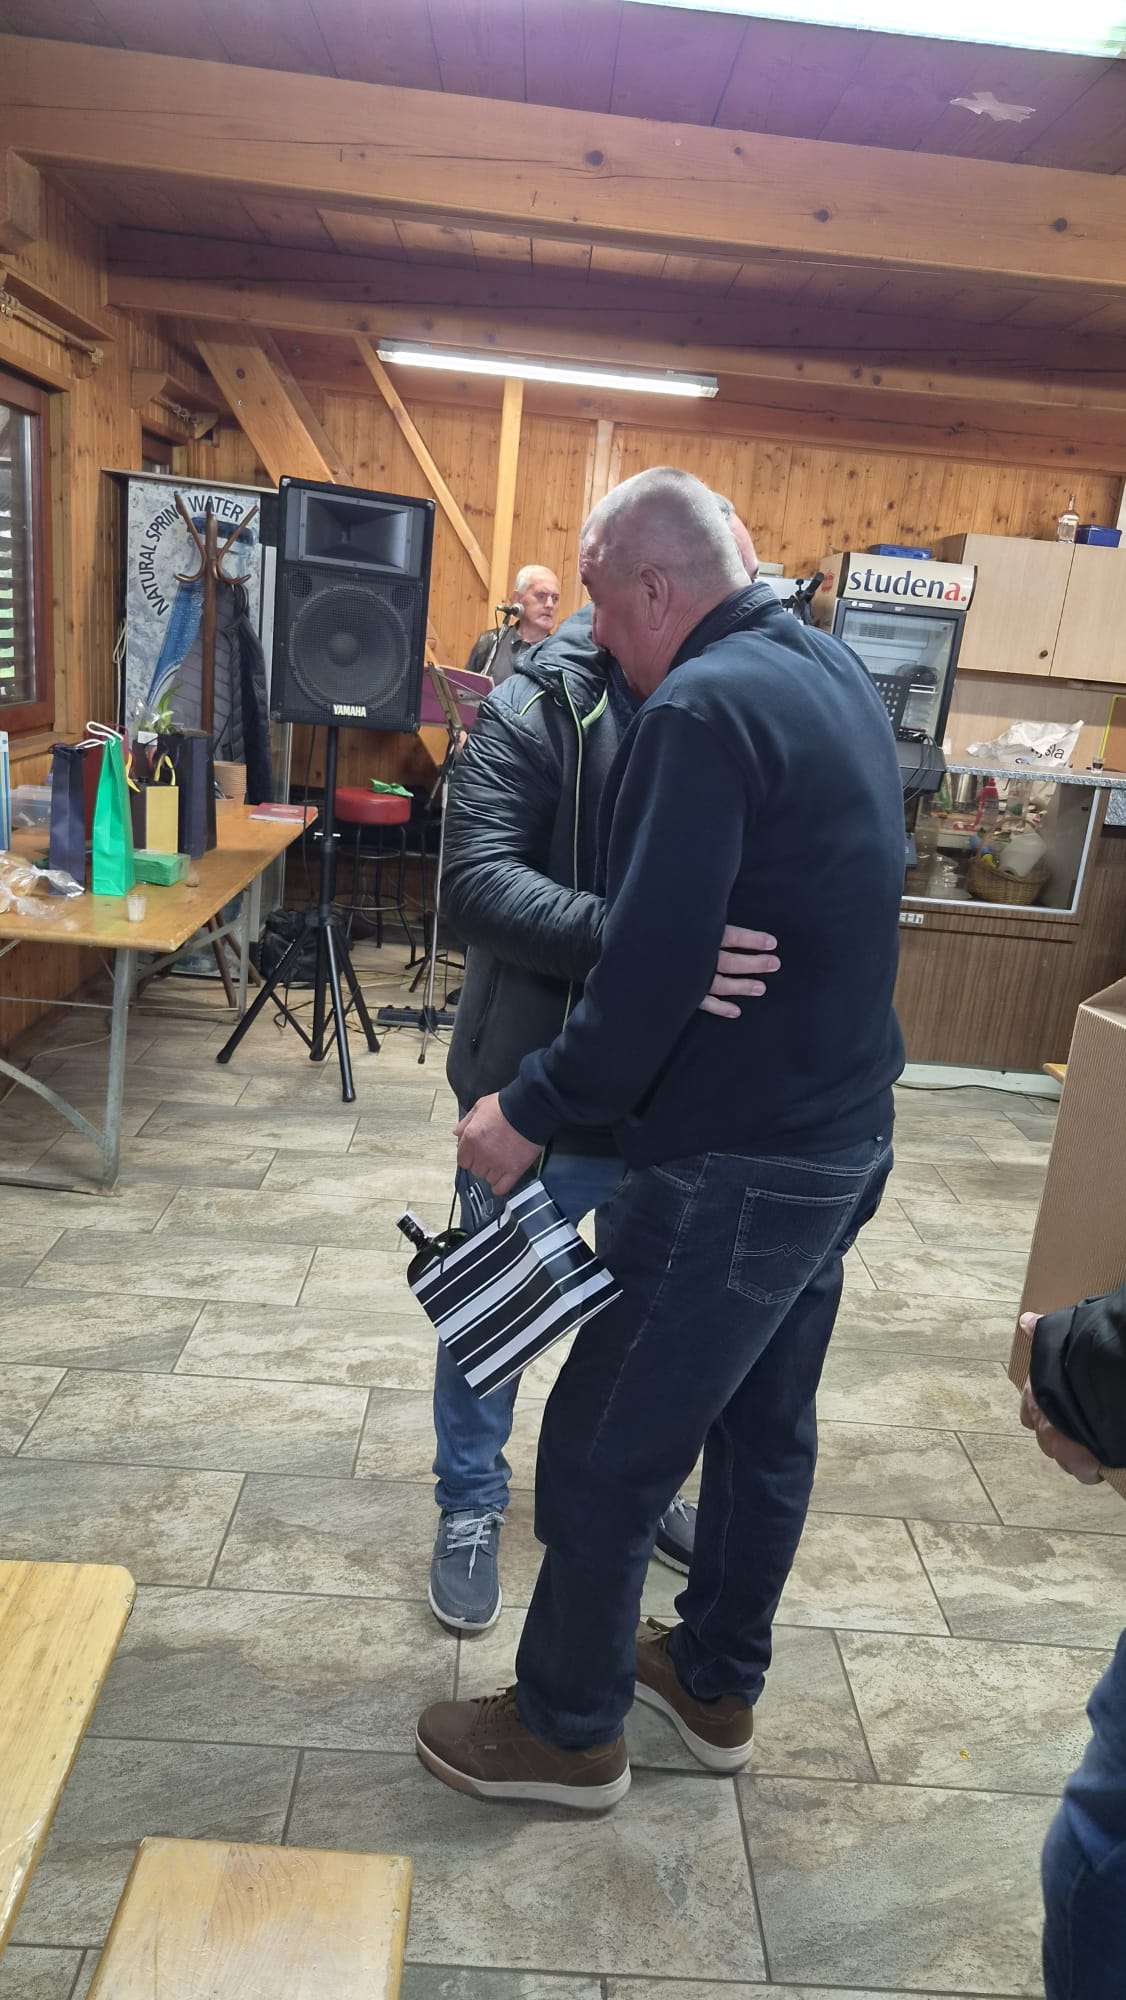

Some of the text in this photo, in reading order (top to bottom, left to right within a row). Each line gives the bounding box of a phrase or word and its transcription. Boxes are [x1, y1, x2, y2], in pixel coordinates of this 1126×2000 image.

[139, 495, 244, 617] NATURAL SPRIN WATER
[333, 703, 367, 718] YAMAHA
